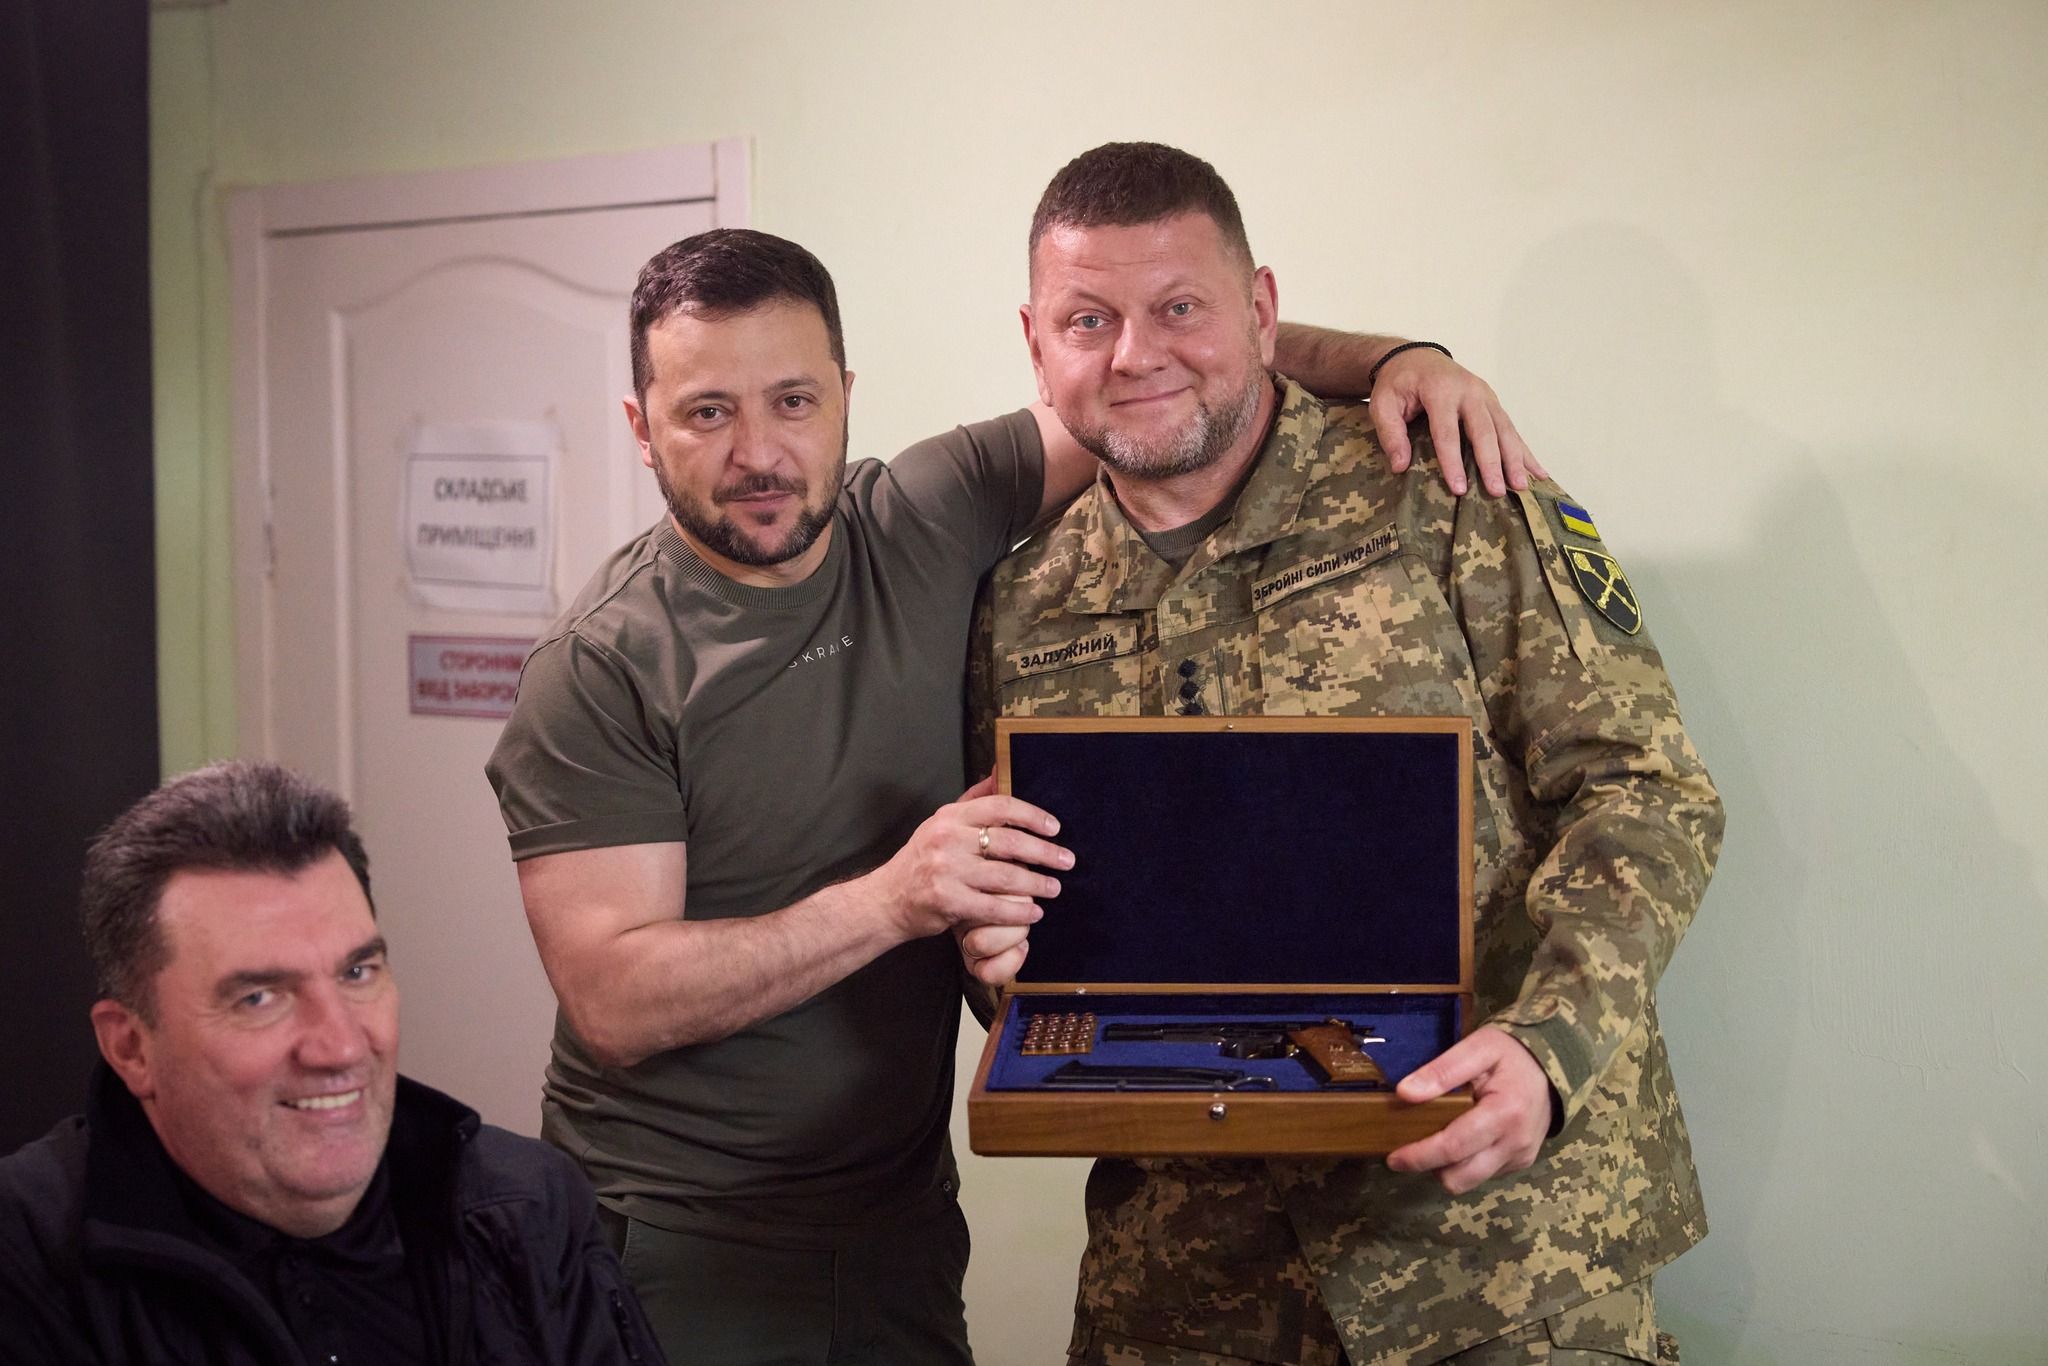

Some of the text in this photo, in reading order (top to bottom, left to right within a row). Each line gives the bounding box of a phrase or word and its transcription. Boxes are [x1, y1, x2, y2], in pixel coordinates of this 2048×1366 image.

[1253, 532, 1393, 601] ЗБРОЙНІ СИЛИ УКРАЇНИ
[1020, 632, 1115, 669] ЗАЛУЖНИЙ
